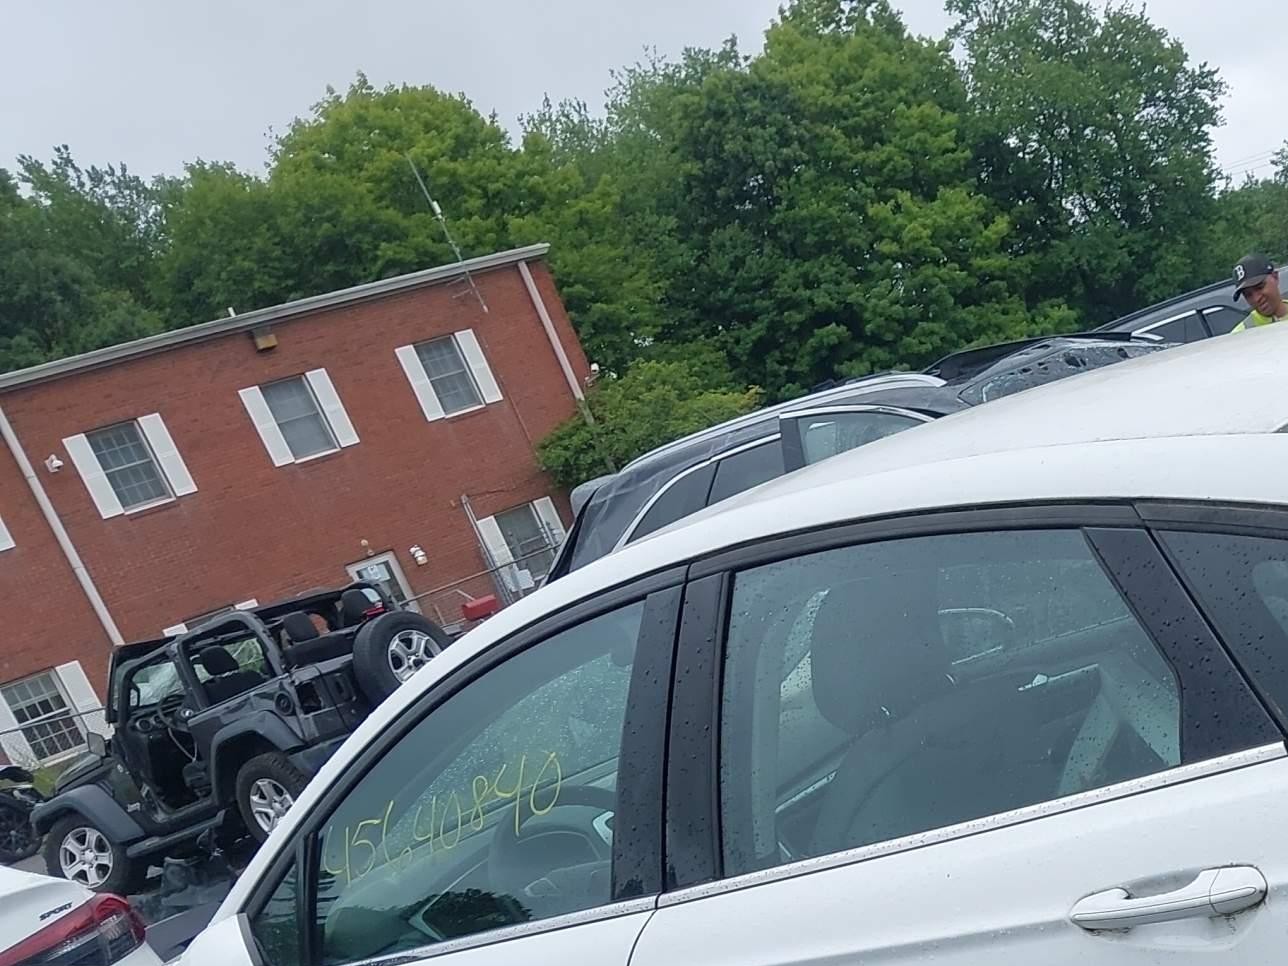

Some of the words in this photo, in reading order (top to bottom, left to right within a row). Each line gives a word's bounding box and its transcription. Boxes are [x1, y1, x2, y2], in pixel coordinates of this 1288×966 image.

[1234, 264, 1245, 281] B
[323, 750, 562, 888] 45640840
[39, 901, 73, 921] SPORT
